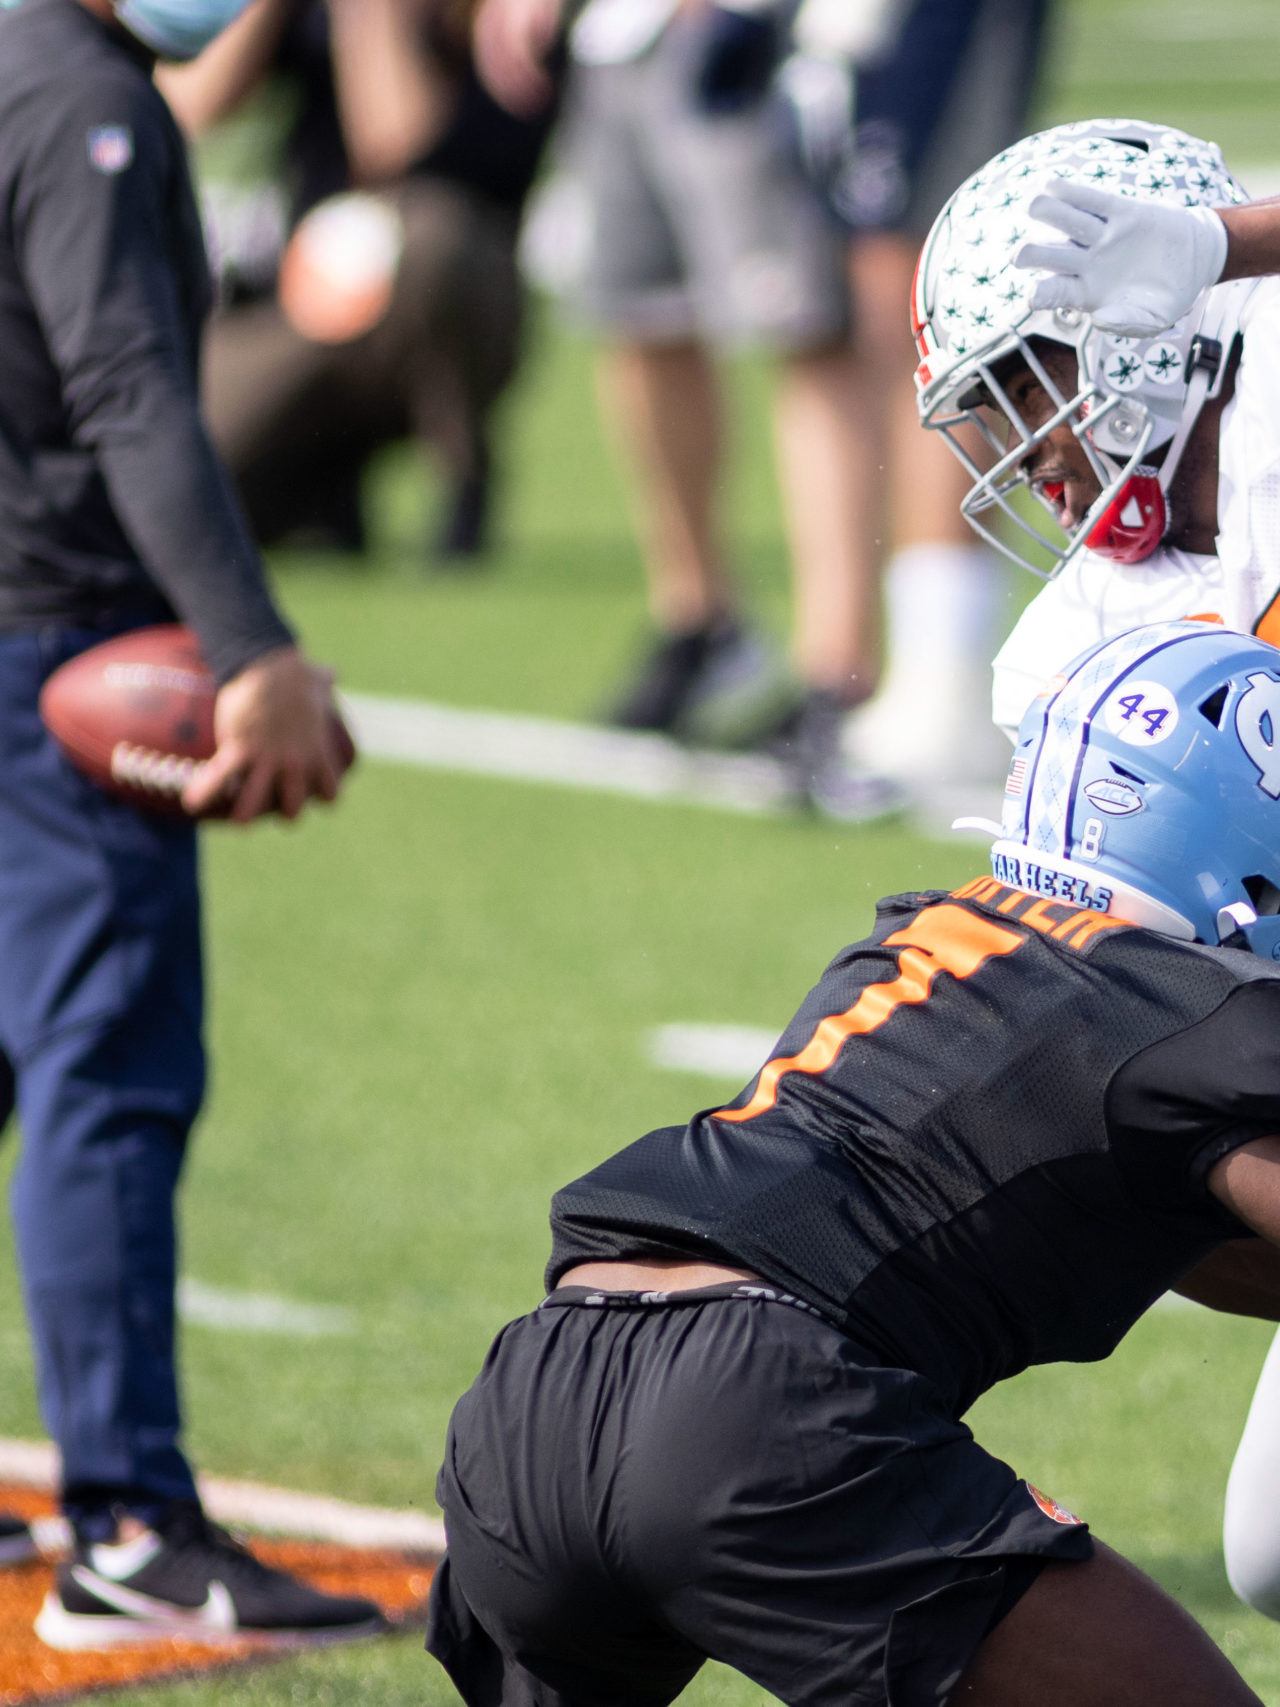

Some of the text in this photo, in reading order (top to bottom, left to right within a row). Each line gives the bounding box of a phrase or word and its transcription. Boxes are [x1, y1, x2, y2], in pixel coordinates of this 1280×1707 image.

[1118, 693, 1171, 738] 44
[1094, 786, 1137, 807] ACC
[1080, 817, 1104, 861] 8
[990, 853, 1022, 887] TAR
[1022, 861, 1113, 913] HEELS
